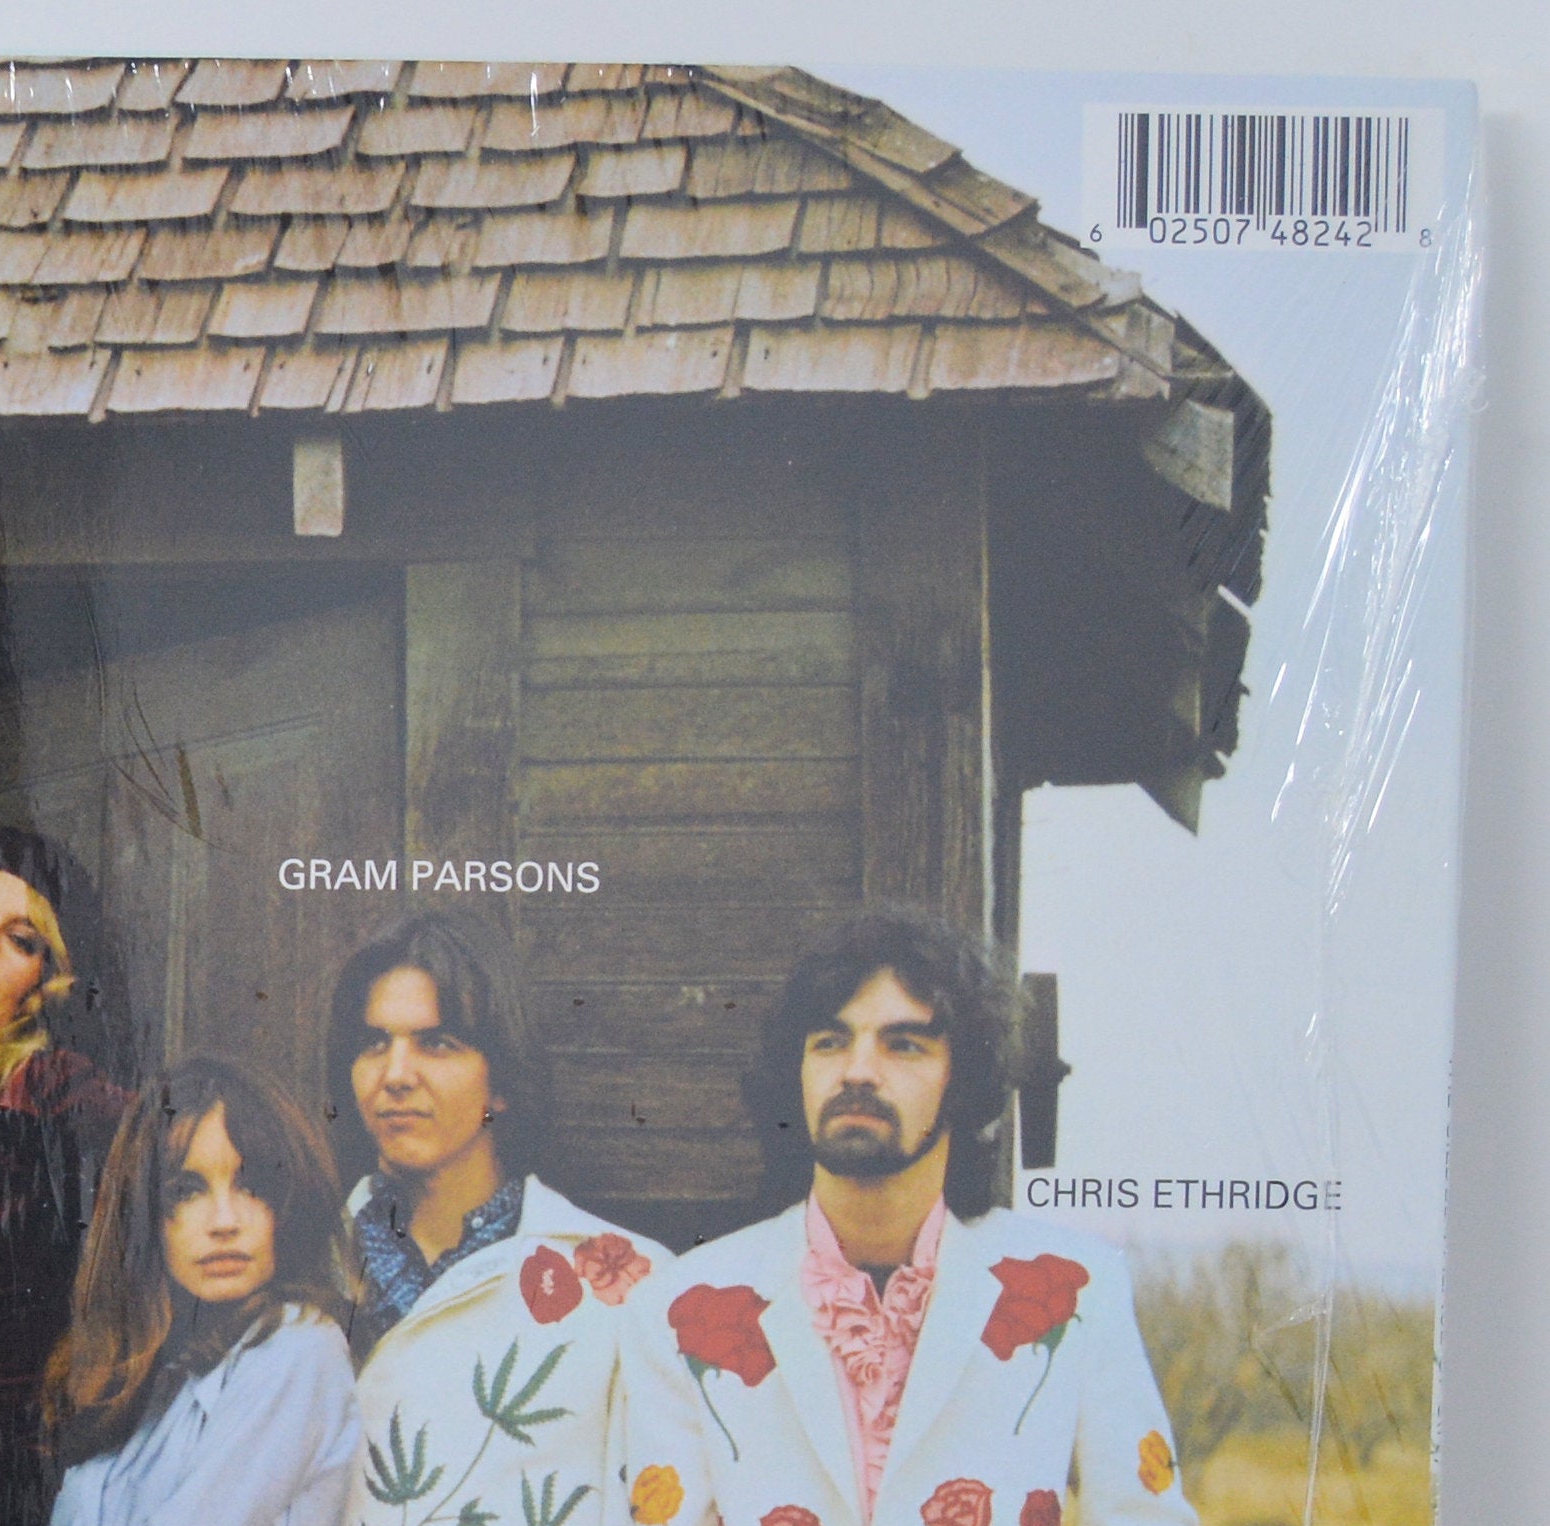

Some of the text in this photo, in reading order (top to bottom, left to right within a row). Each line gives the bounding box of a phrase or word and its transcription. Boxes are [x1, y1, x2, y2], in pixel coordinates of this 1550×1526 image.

[1089, 216, 1433, 249] 6 02507 48242 8
[278, 858, 600, 894] GRAM PARSONS
[1026, 1177, 1342, 1211] CHRIS ETHRIDGE
